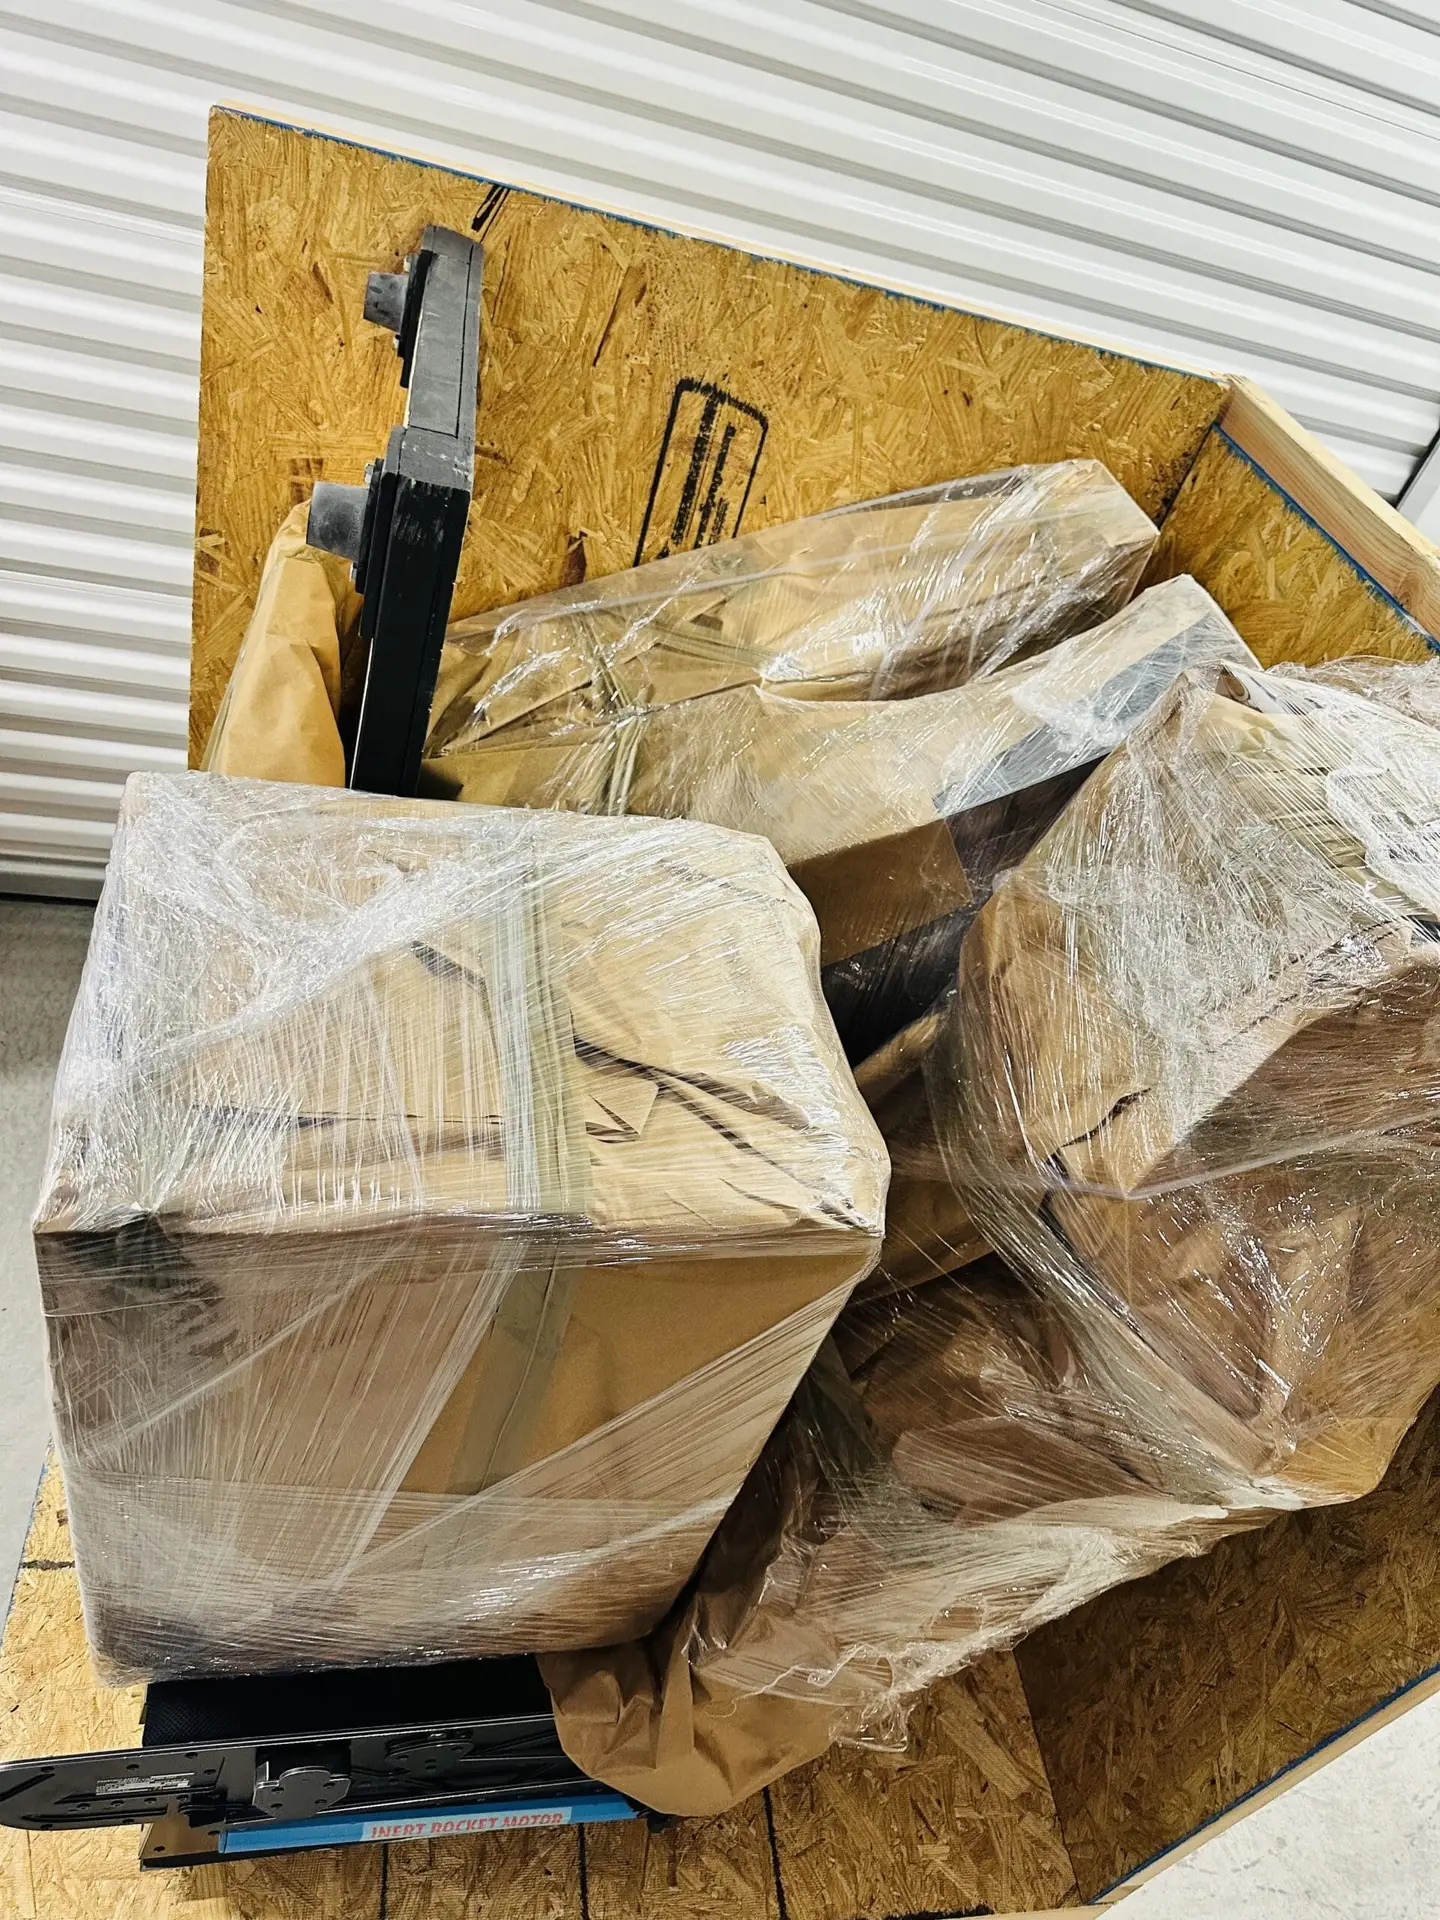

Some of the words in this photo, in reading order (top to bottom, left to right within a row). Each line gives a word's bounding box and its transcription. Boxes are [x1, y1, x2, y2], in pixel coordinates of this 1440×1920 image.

[371, 1823, 426, 1838] INERT
[430, 1817, 499, 1833] ROCKET
[502, 1813, 563, 1827] MOTOR
